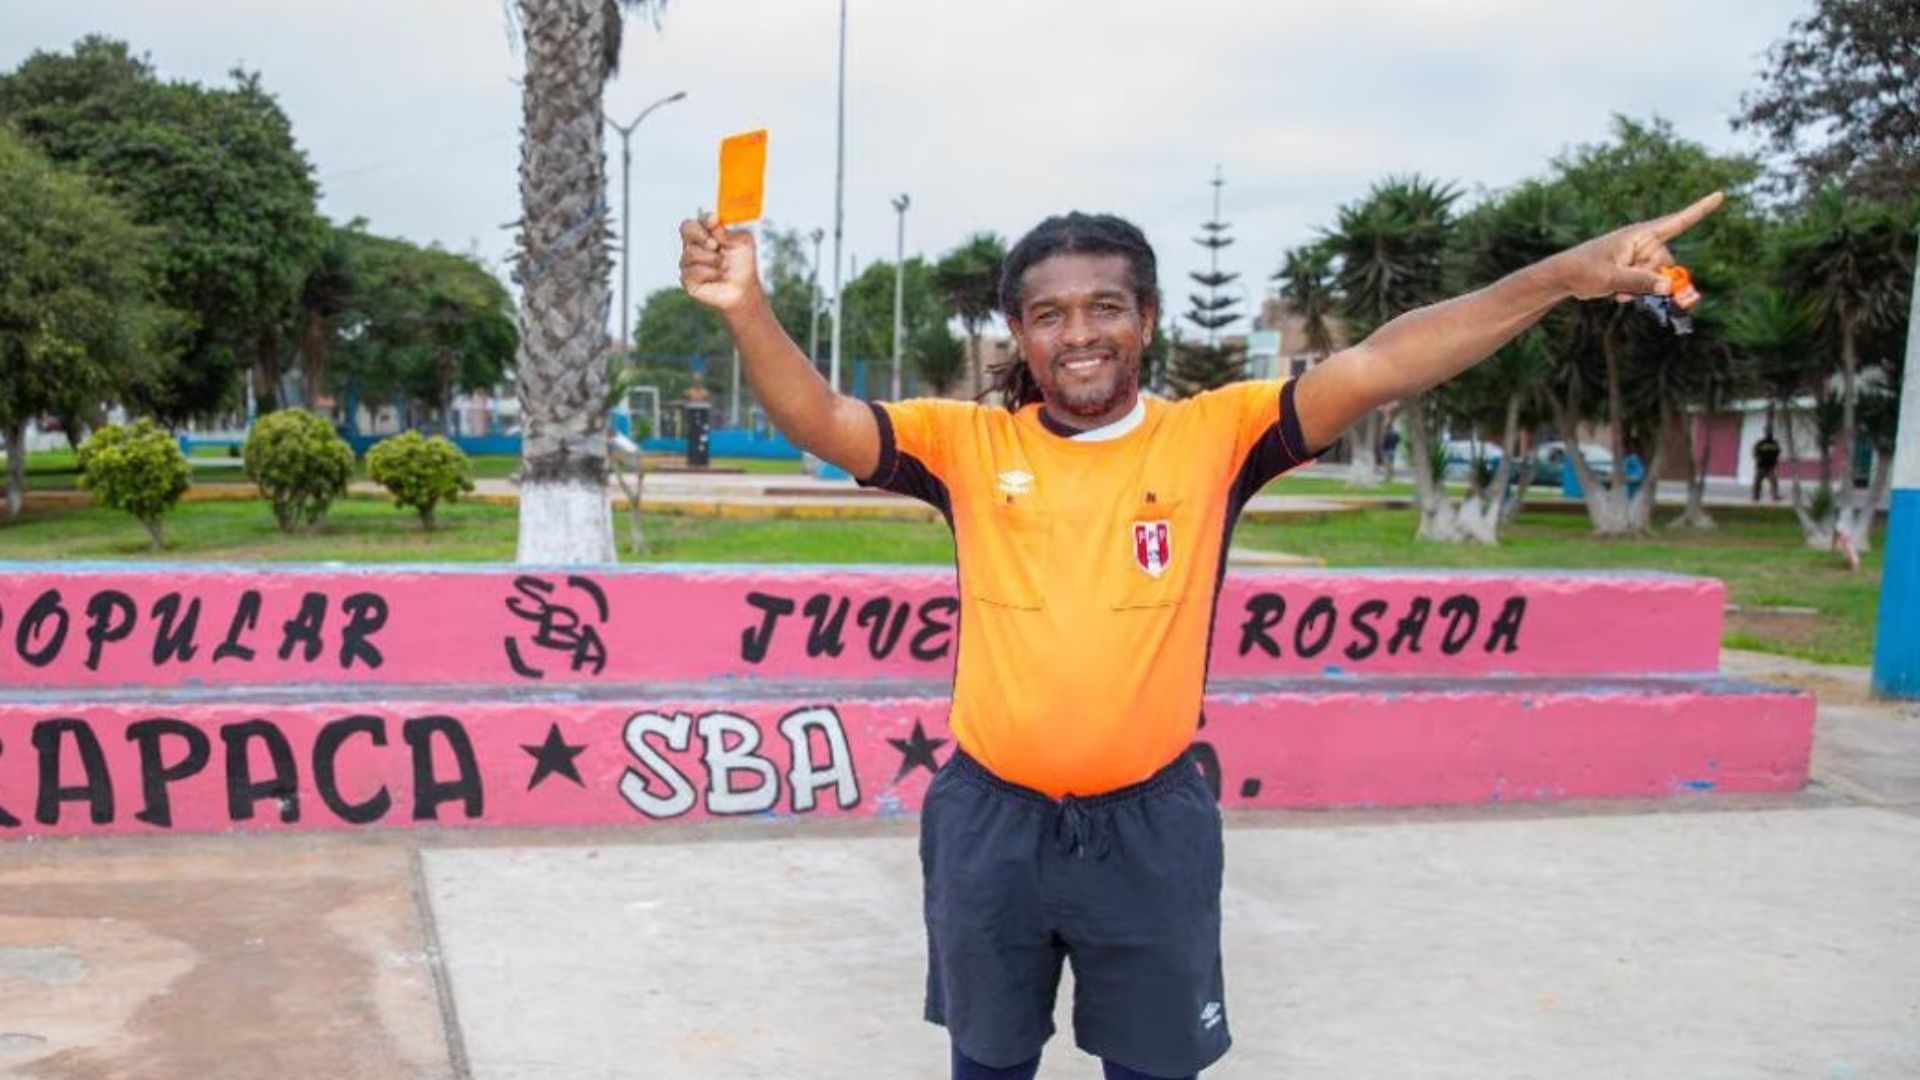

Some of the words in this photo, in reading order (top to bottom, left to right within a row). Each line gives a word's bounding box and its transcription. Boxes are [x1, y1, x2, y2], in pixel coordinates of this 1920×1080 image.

[0, 589, 388, 671] OPULAR
[505, 576, 606, 675] SBA
[1239, 593, 1526, 661] ROSADA
[618, 706, 860, 819] SBA
